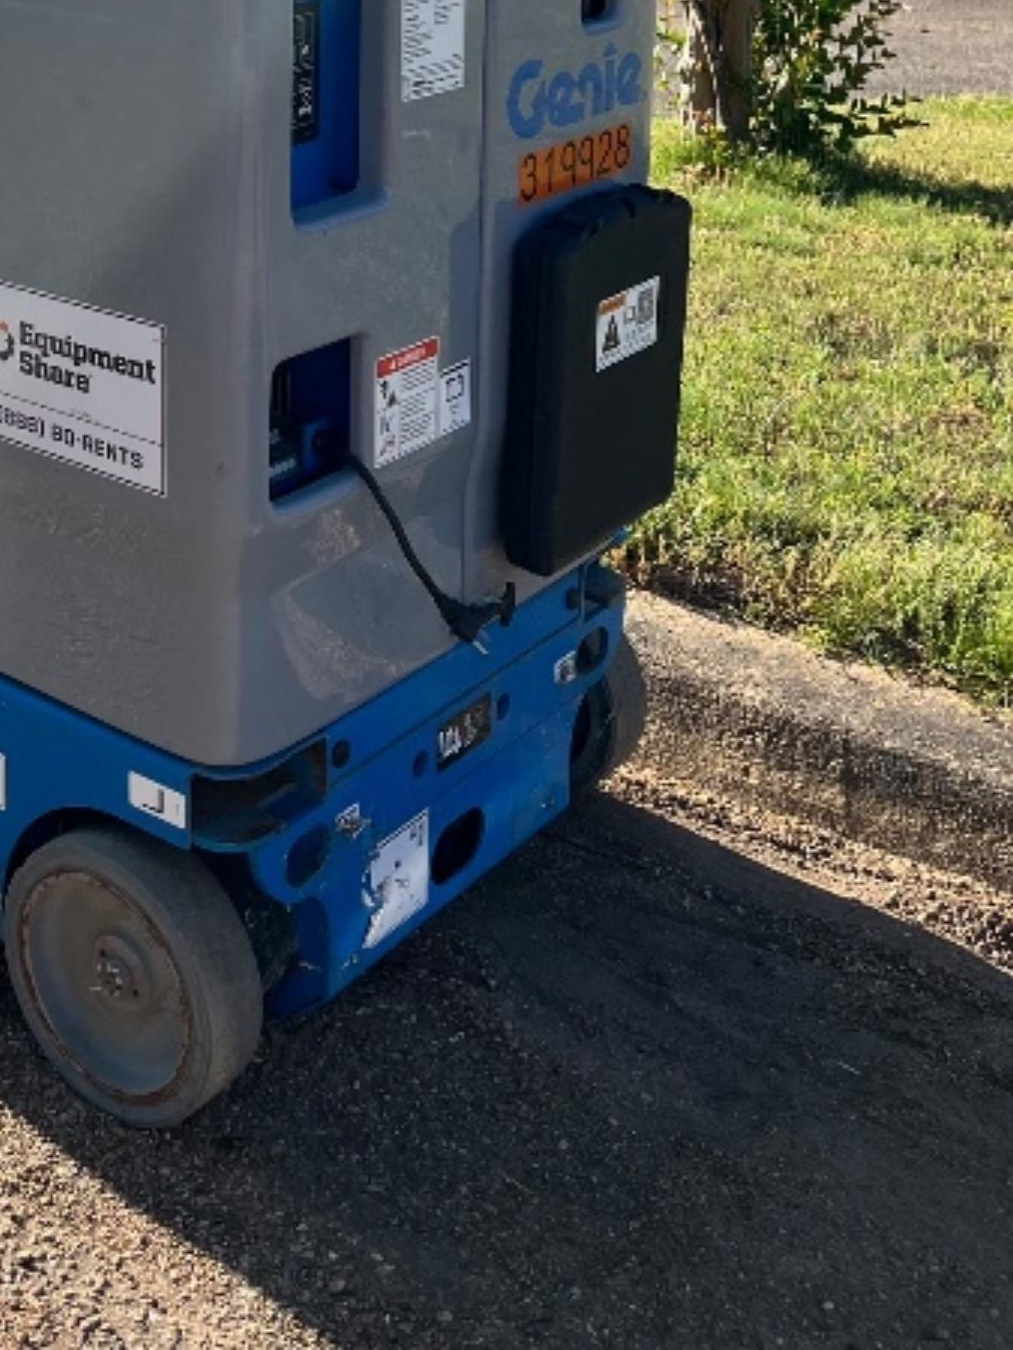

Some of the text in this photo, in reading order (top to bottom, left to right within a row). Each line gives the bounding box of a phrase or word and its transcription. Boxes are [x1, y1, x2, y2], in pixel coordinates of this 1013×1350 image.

[506, 41, 642, 139] Genie
[520, 123, 631, 202] 319928
[19, 320, 156, 385] Equipment
[19, 350, 90, 394] Share
